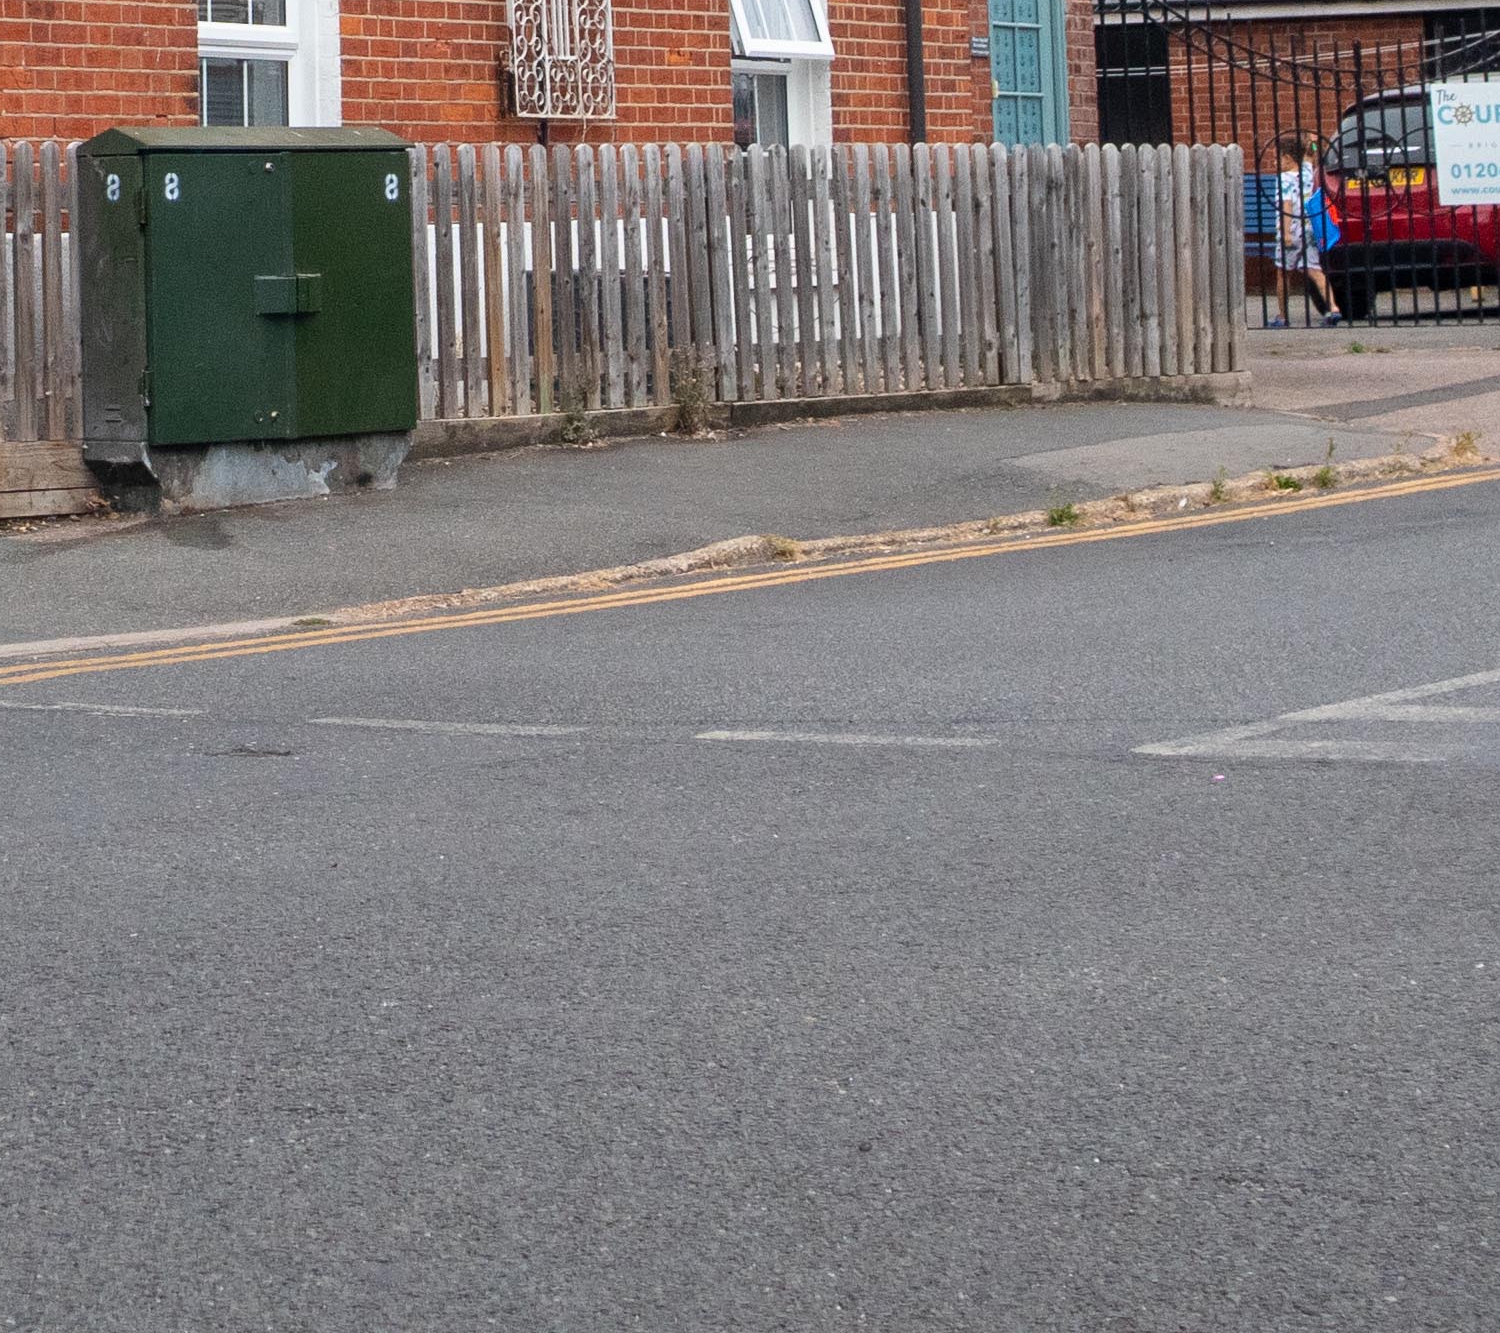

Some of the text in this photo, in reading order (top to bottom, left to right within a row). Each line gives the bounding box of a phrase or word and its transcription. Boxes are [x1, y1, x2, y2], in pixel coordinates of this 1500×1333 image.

[1436, 88, 1457, 105] The
[106, 173, 121, 201] 8
[164, 172, 180, 201] 8
[384, 173, 399, 201] 8
